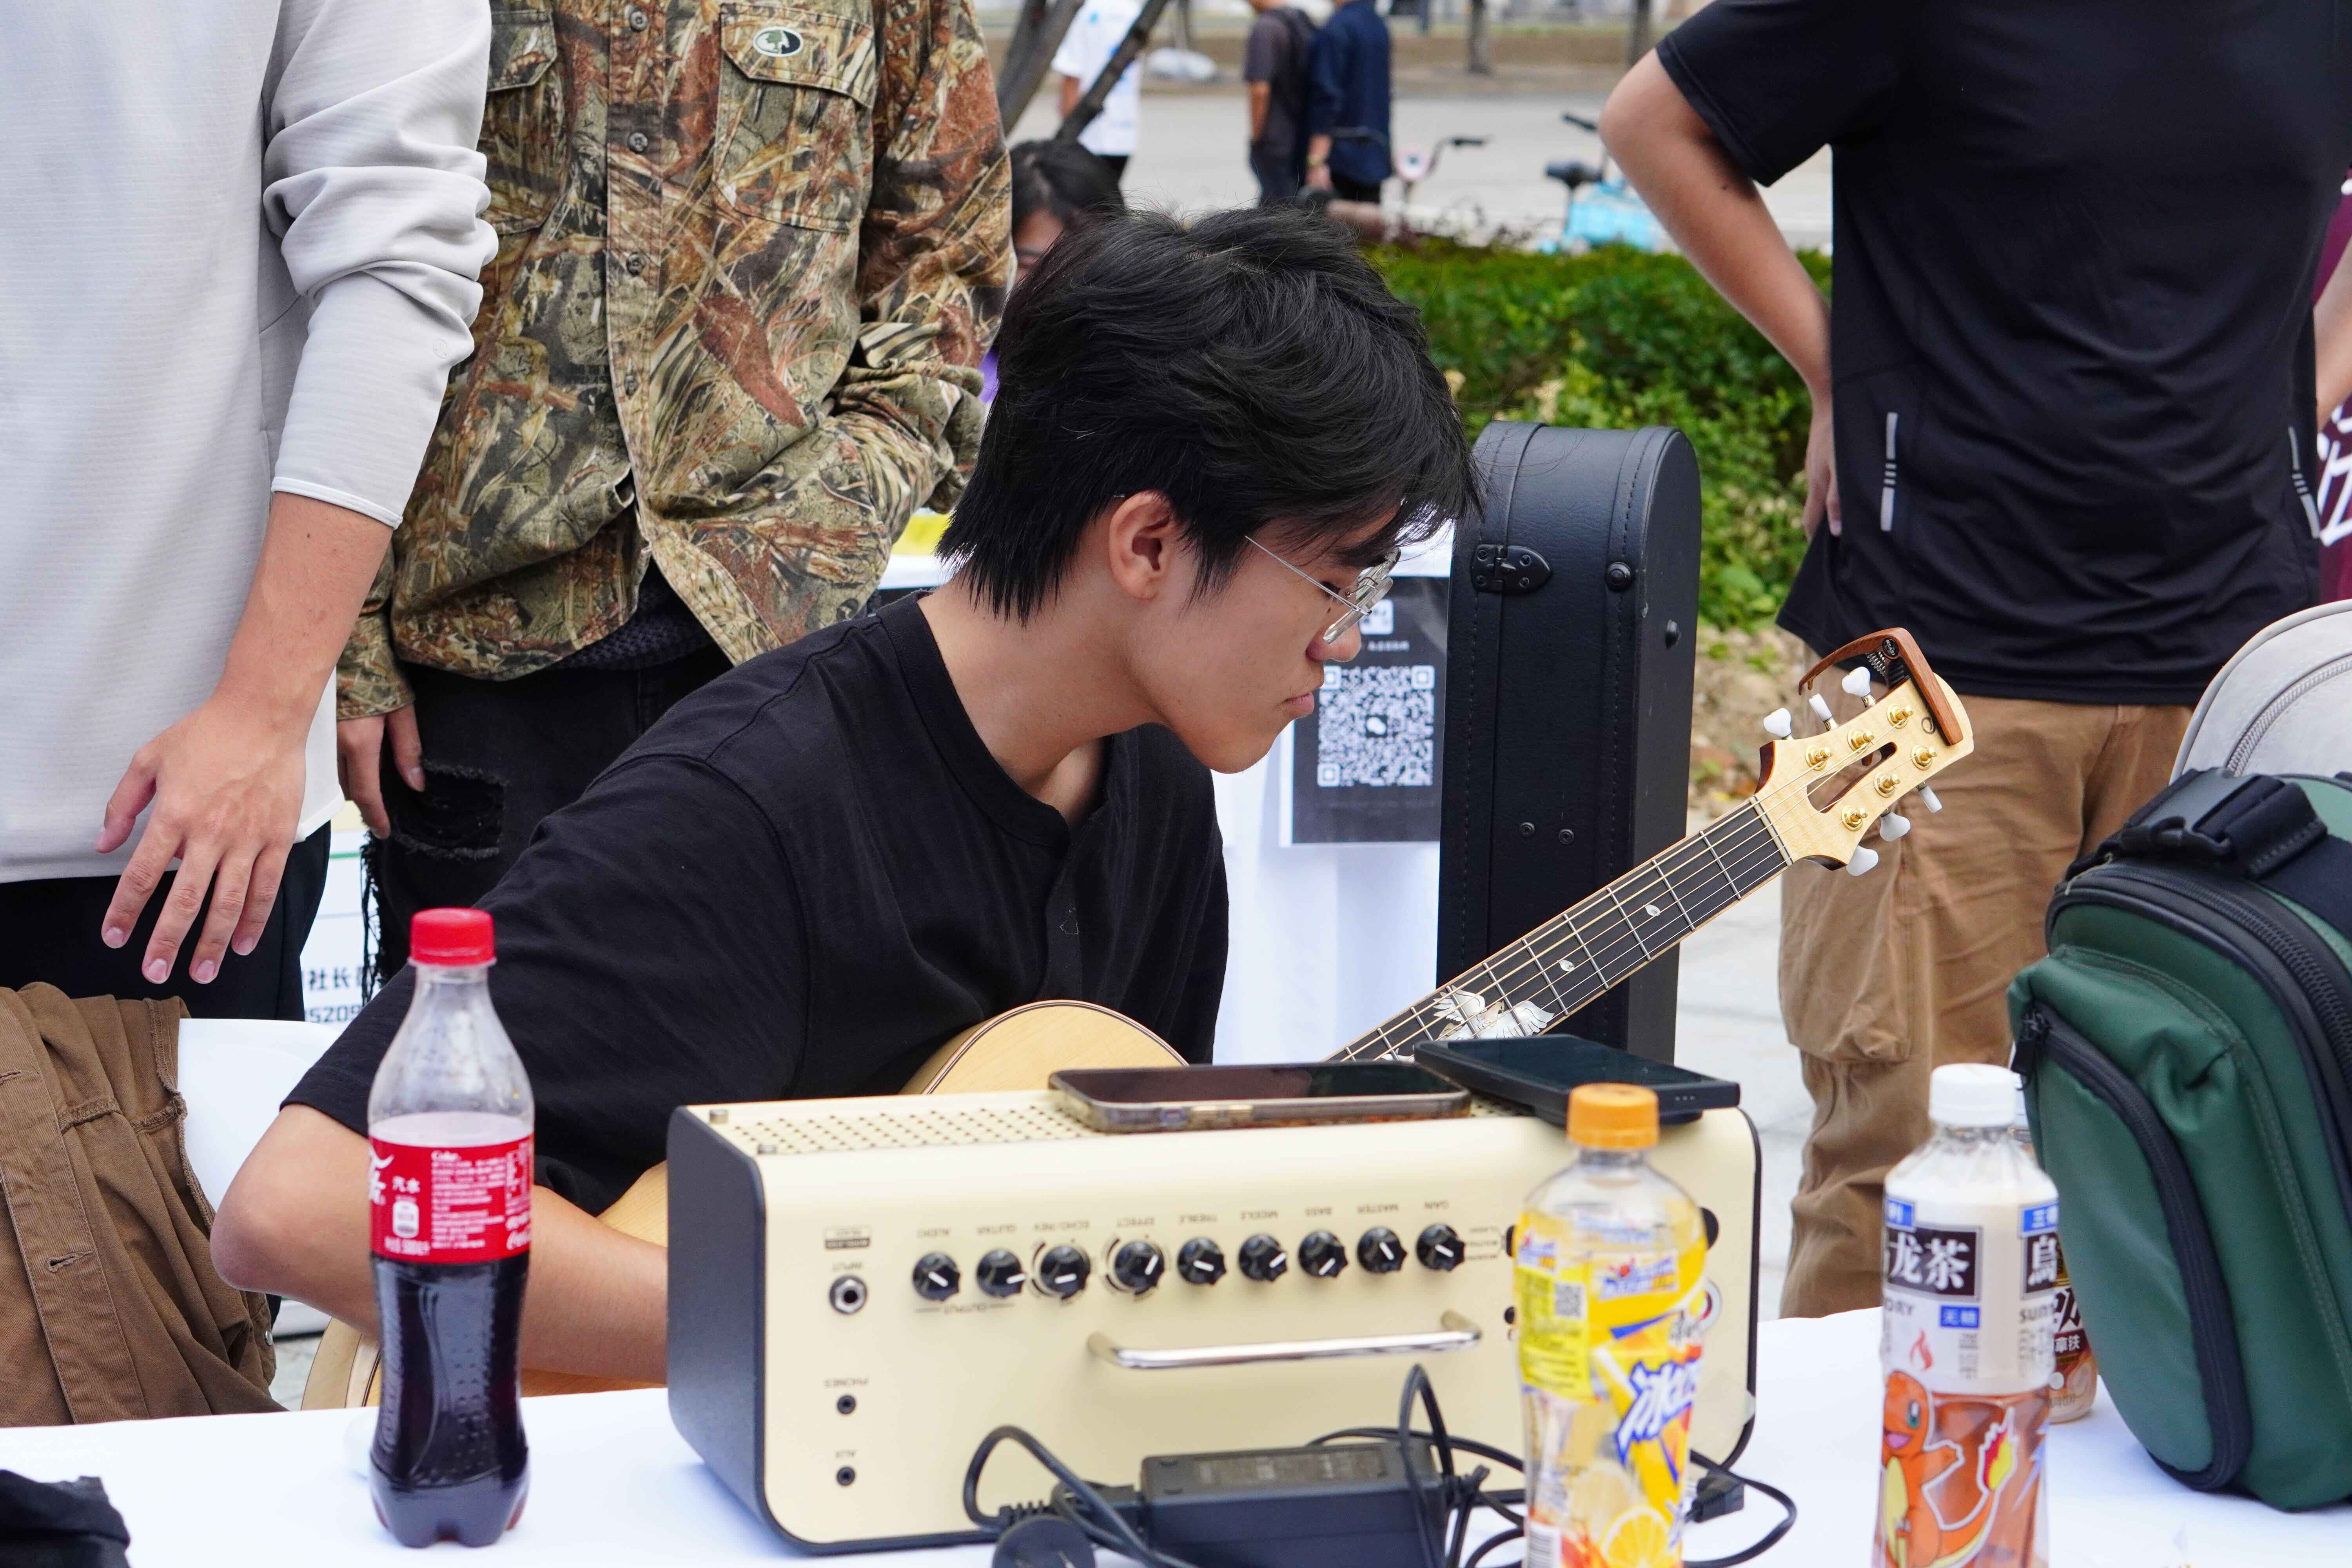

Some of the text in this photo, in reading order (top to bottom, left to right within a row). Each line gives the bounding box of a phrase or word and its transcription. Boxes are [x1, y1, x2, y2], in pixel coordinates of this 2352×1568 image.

[1357, 1203, 1399, 1214] MASTER
[1424, 1200, 1449, 1210] GAIN
[1240, 1210, 1278, 1221] MIDDLE
[1305, 1207, 1332, 1217] BASS
[1116, 1216, 1155, 1228] EFFECT
[1179, 1213, 1217, 1223] TREBLE
[917, 1228, 951, 1238] AUDIO
[976, 1223, 1016, 1236] GUITAR
[833, 1261, 862, 1271] INPUT
[944, 1303, 987, 1314] OUTPUT
